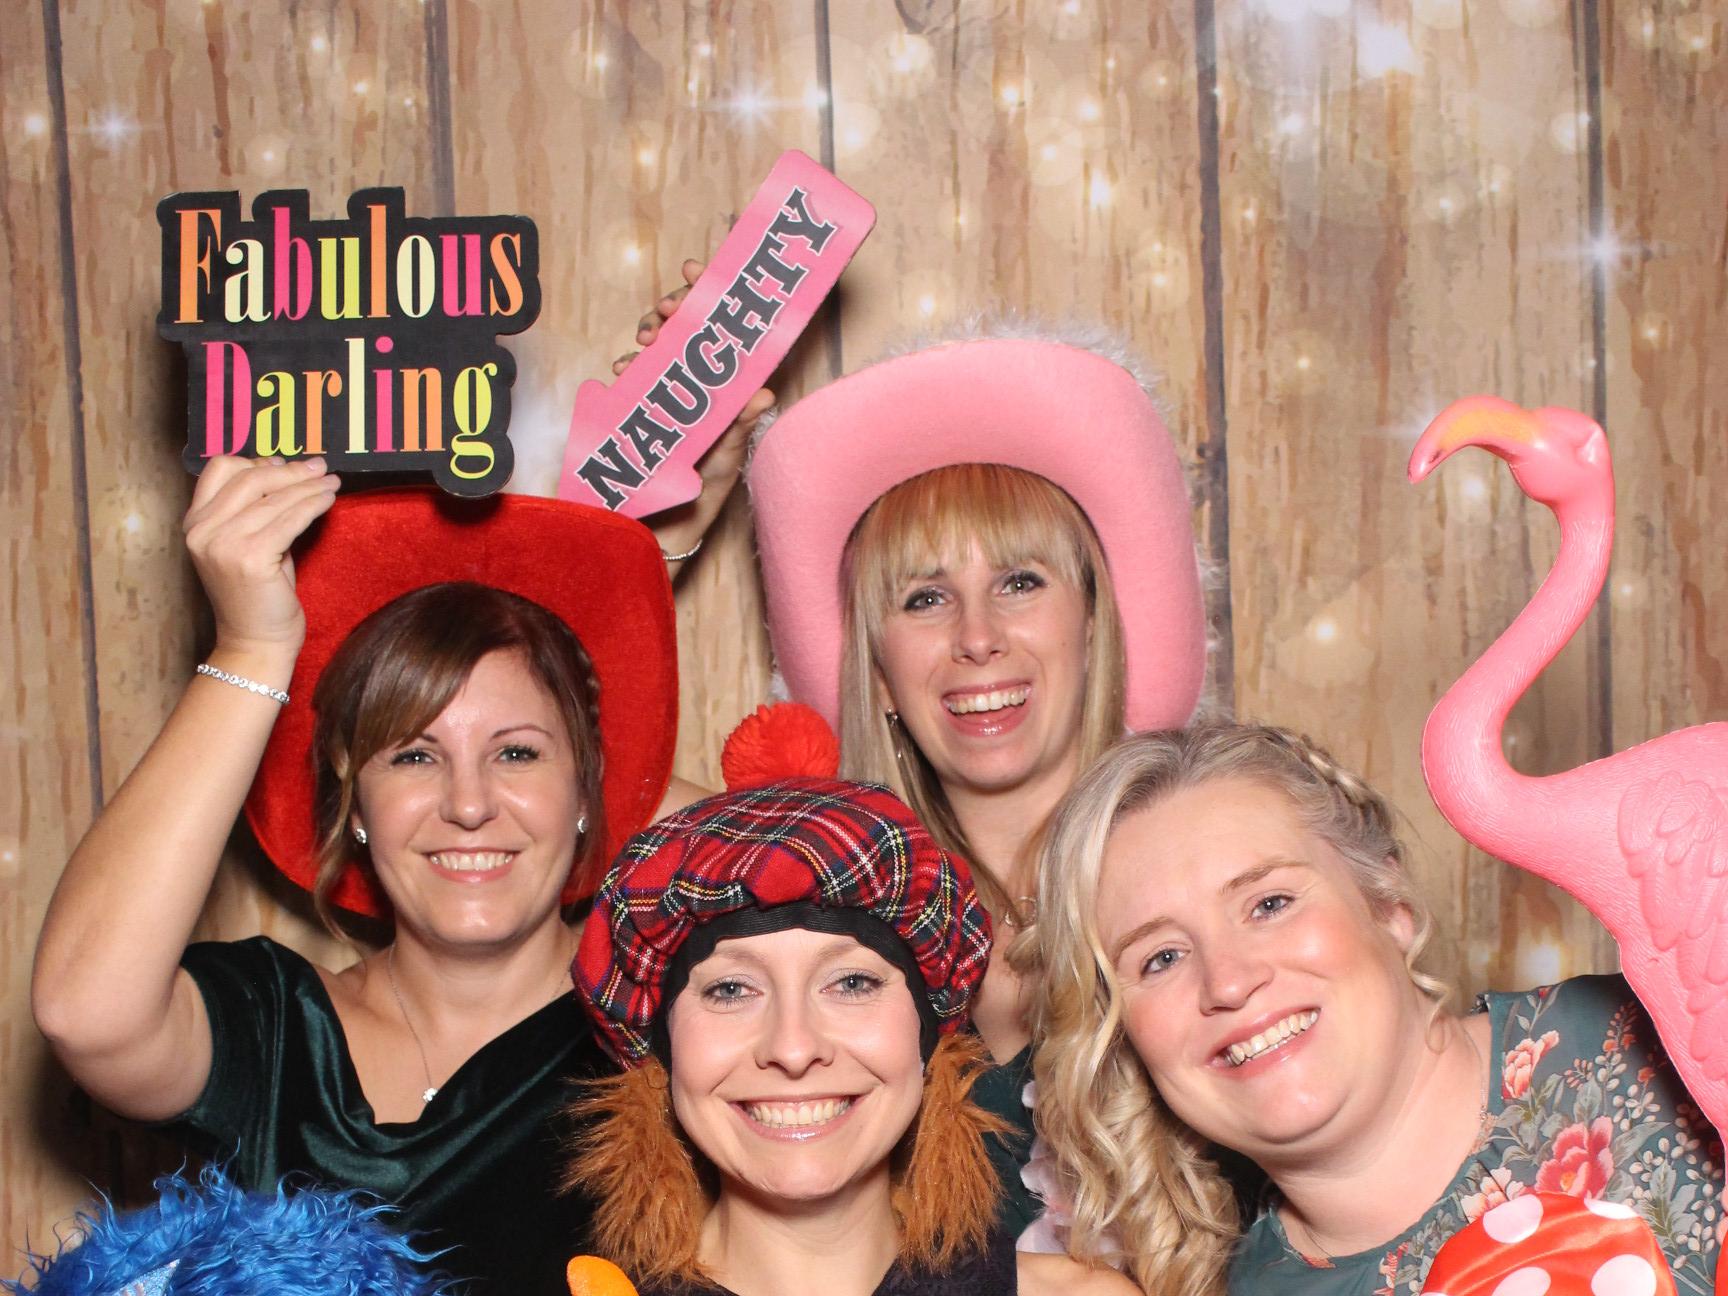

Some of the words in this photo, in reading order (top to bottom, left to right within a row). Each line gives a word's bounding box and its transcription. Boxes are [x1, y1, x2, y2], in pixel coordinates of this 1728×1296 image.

[174, 204, 524, 323] Fabulous
[200, 336, 498, 479] Darling
[574, 185, 838, 511] NAUGHTY
